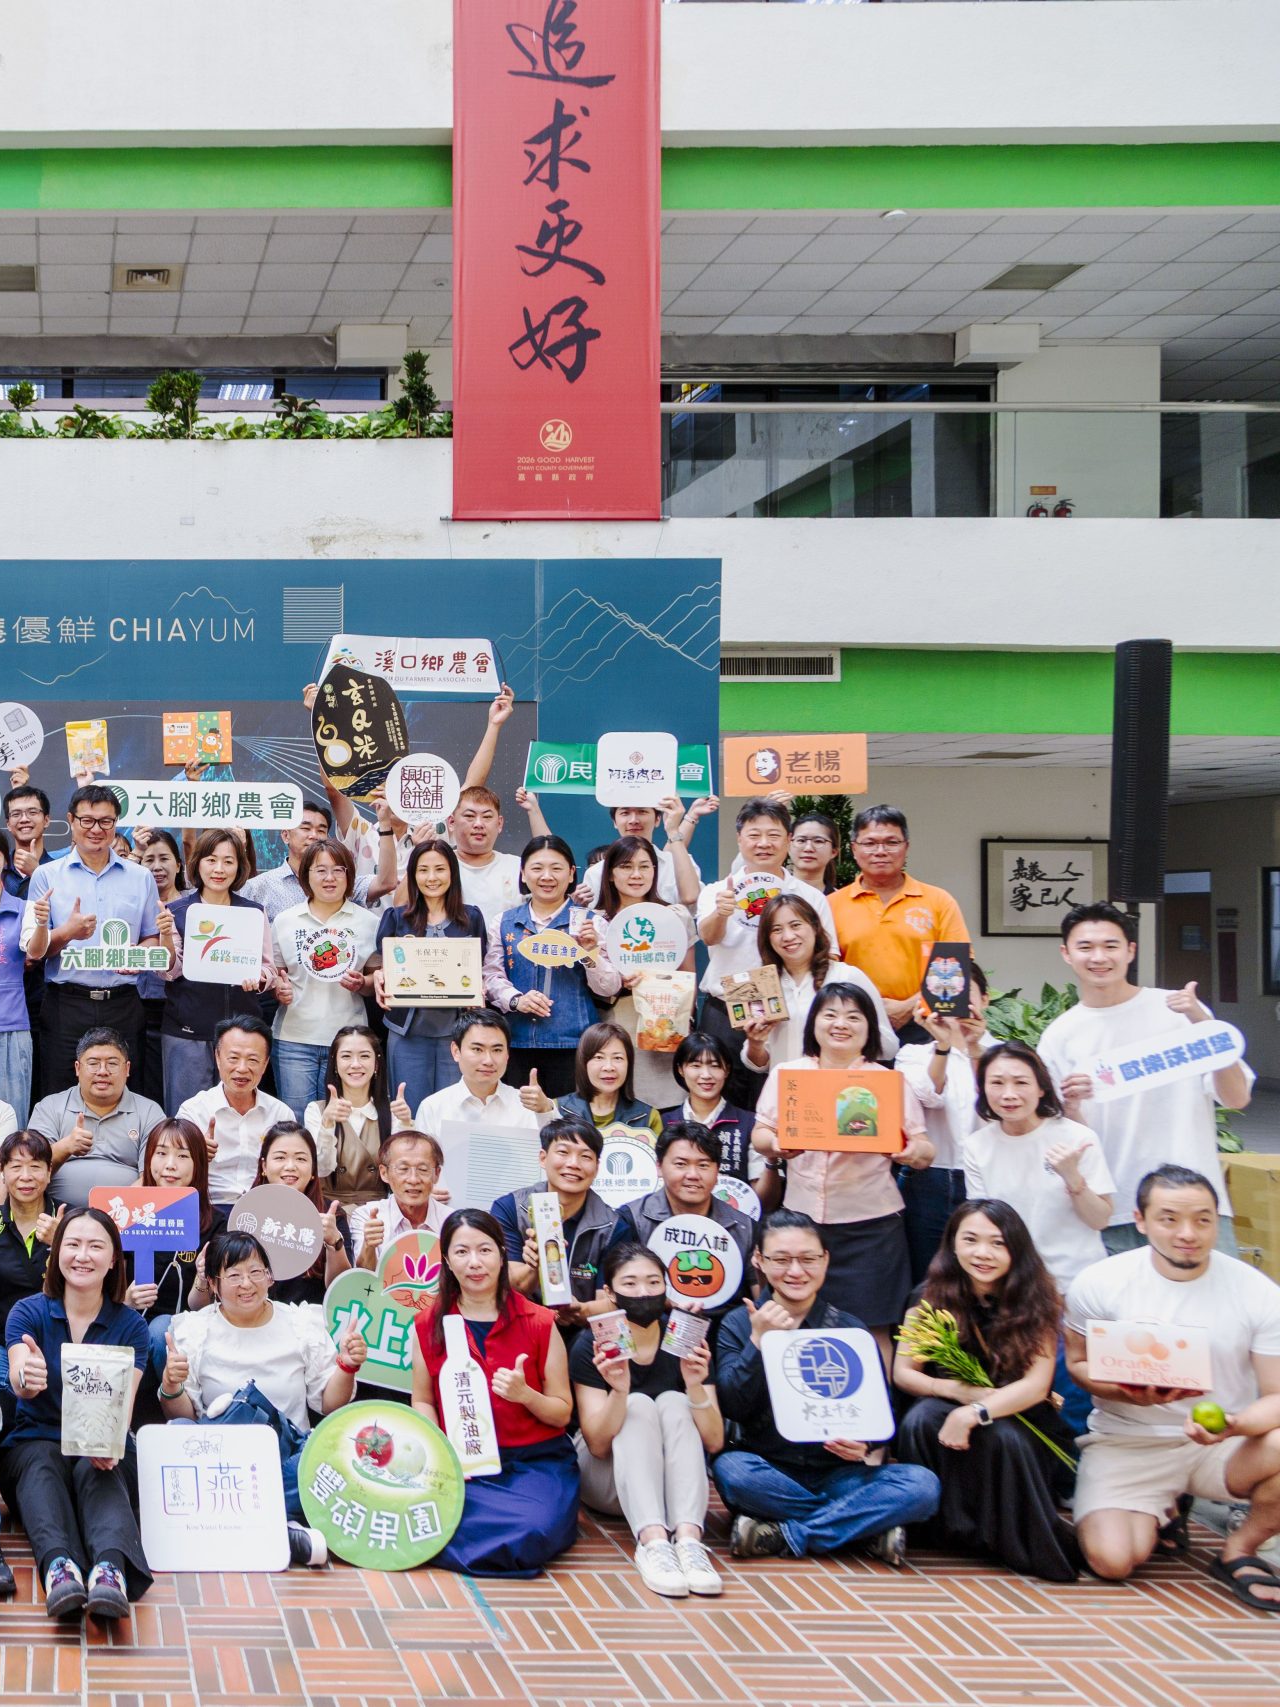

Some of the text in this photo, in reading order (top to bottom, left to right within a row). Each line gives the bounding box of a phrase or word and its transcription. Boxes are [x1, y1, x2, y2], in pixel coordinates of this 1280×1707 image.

[506, 0, 616, 384] 追求更好
[109, 617, 256, 642] CHIAYUM
[374, 650, 492, 674] 溪口鄉農會
[805, 775, 841, 784] FOOD
[136, 790, 297, 820] 六腳鄉農會
[63, 948, 169, 968] 六腳鄉農會
[620, 951, 677, 964] 中埔鄉農會
[261, 1217, 317, 1247] 新東陽
[665, 1227, 729, 1252] 成功人柿
[260, 1235, 313, 1254] HSIN TUNG YANG
[1101, 1356, 1171, 1374] Orange
[1131, 1371, 1200, 1386] Pickers
[454, 1371, 482, 1456] 清元製油廠
